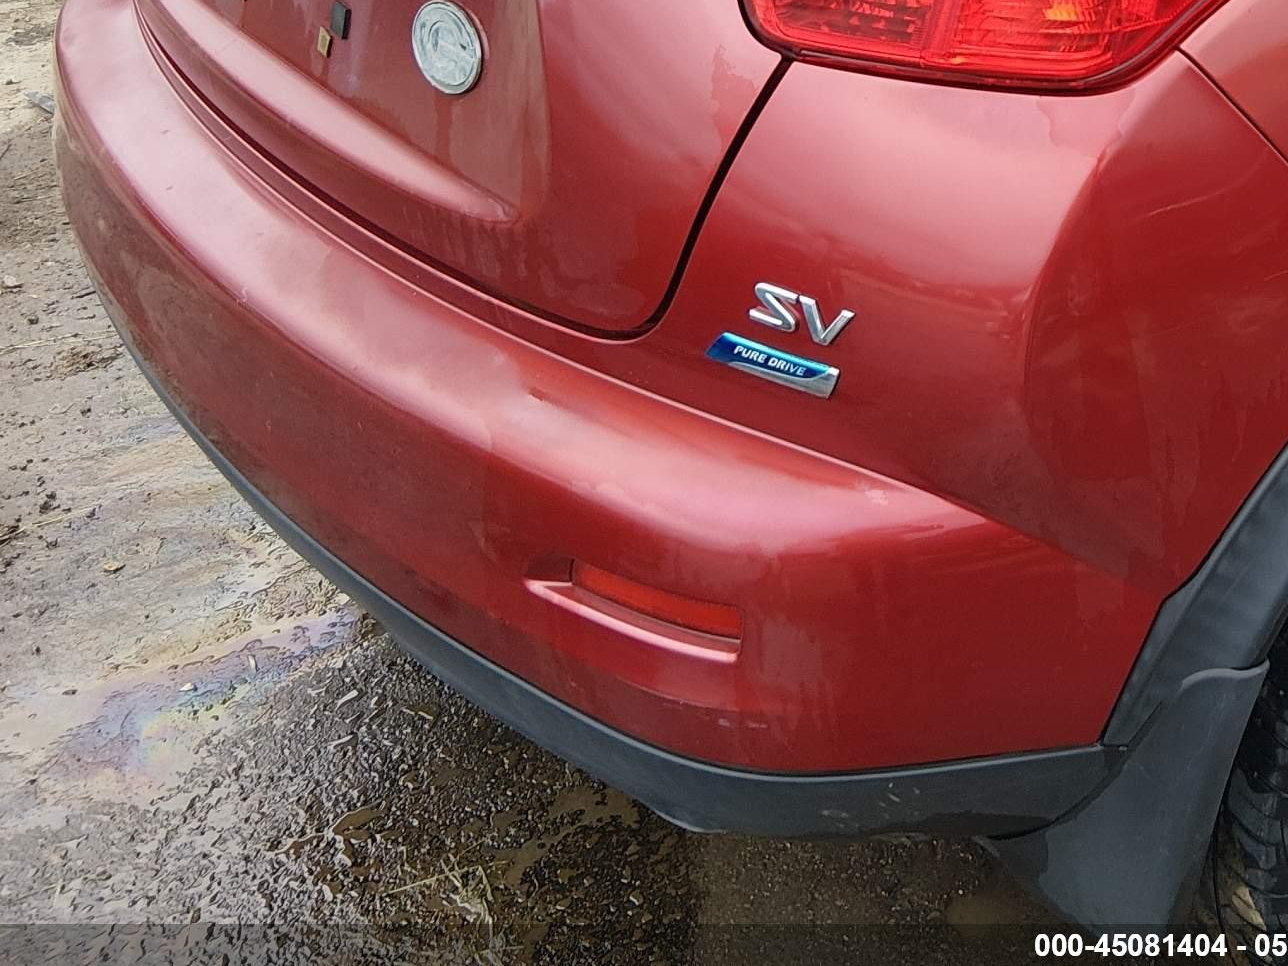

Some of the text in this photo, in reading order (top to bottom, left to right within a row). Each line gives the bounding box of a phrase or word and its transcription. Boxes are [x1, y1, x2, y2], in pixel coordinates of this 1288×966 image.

[748, 282, 856, 346] SV
[734, 346, 807, 376] PURE DRIVE
